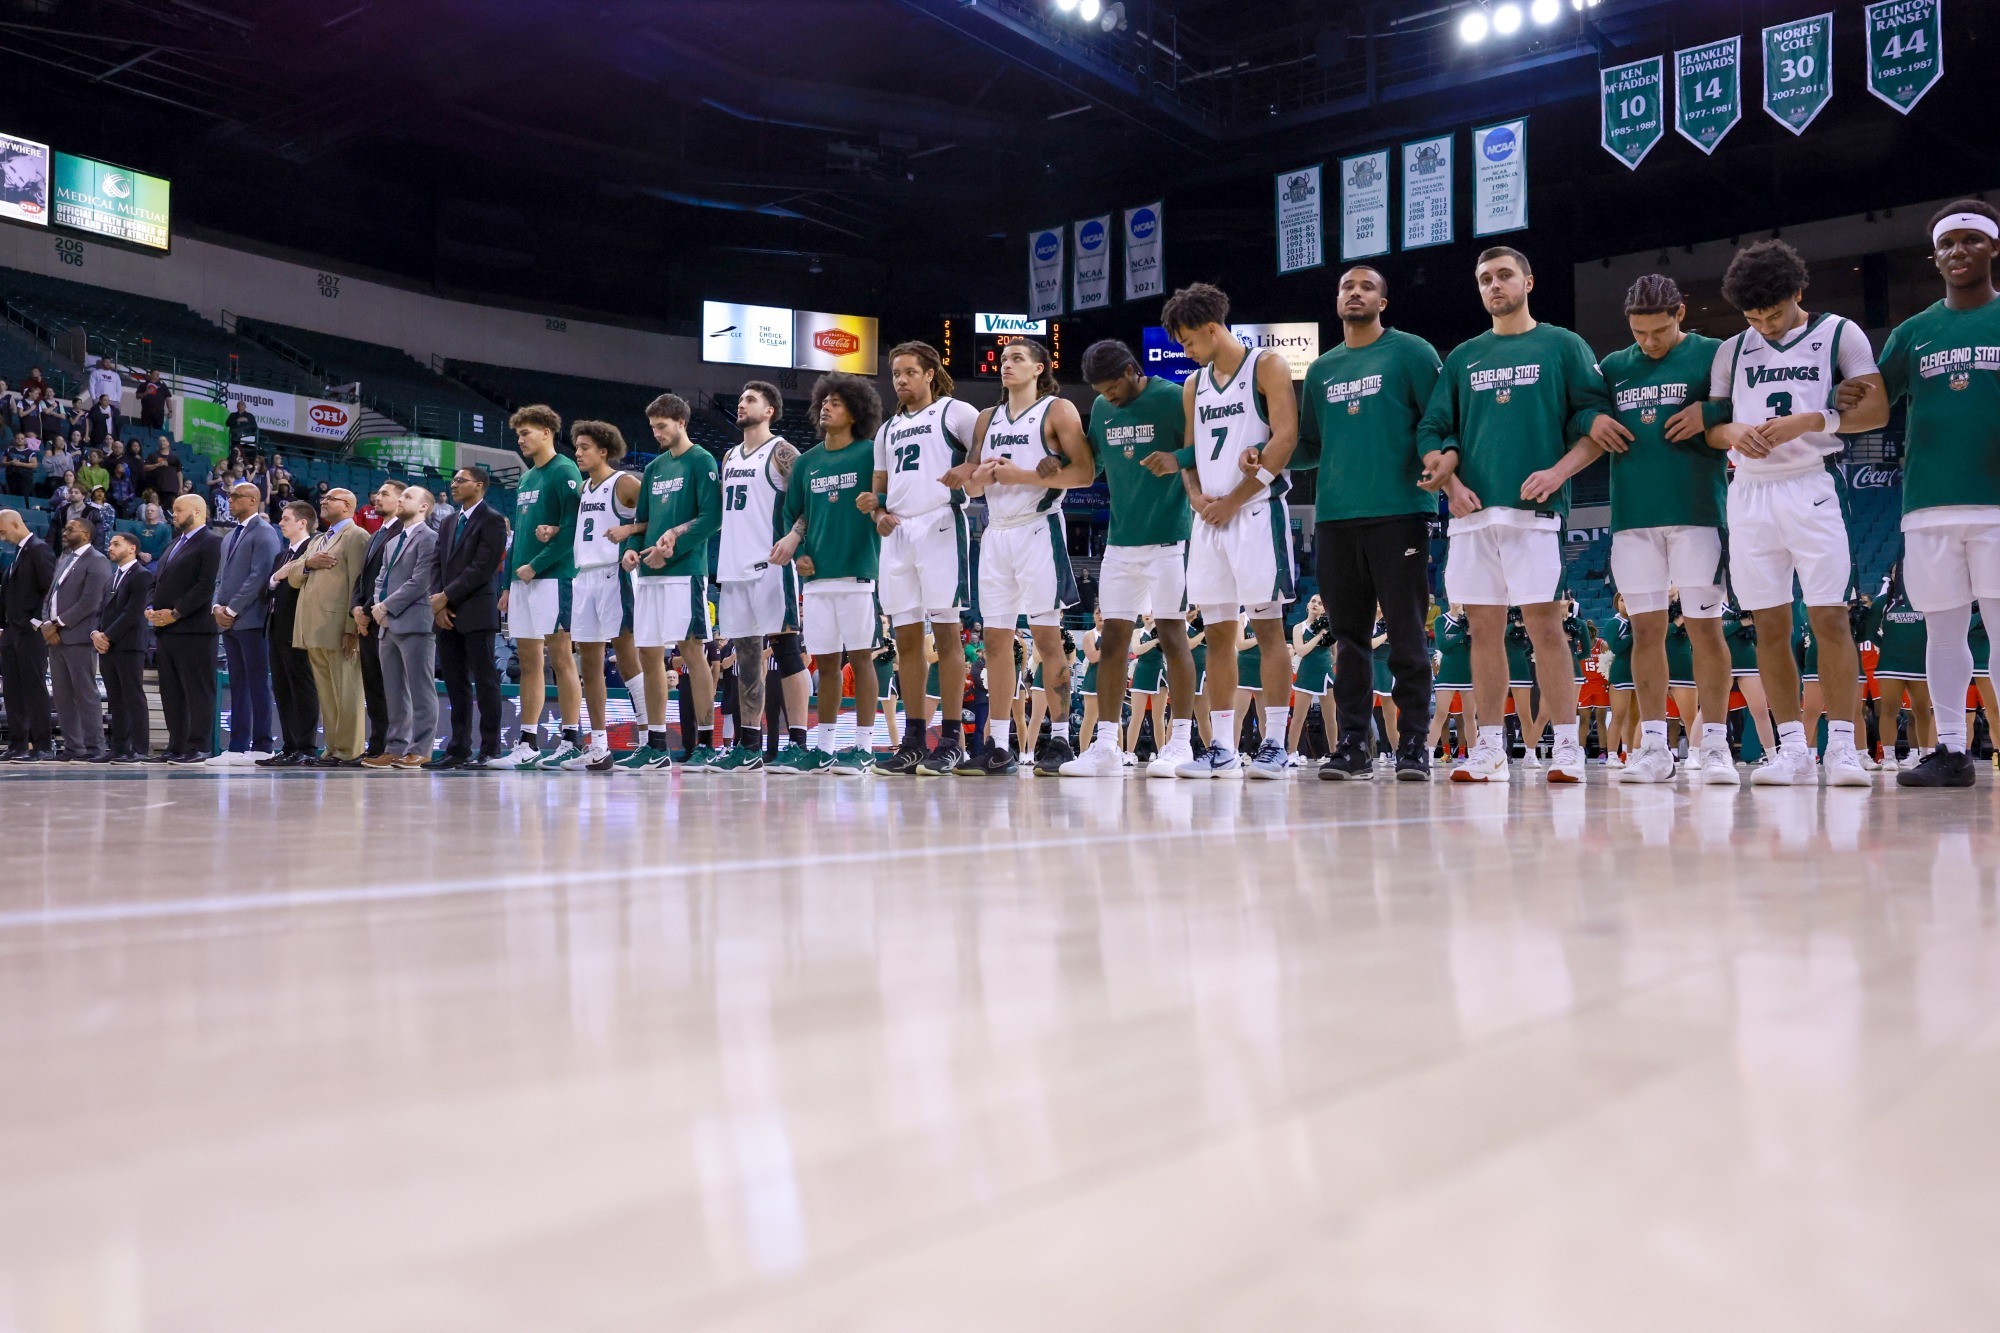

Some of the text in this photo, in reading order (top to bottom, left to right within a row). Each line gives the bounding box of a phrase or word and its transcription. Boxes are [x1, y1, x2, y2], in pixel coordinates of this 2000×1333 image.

[1872, 0, 1935, 21] CLINTON
[1876, 8, 1931, 31] RANSEY
[1773, 22, 1821, 43] NORRIS
[1780, 36, 1813, 52] COLE
[1881, 29, 1928, 60] 44
[1681, 44, 1735, 66] FRANKLIN
[1681, 55, 1735, 77] EDWARDS
[1780, 55, 1814, 82] 30
[1878, 59, 1933, 80] 1983-1987
[1620, 66, 1643, 81] KEN
[1694, 76, 1722, 103] 14
[1772, 83, 1823, 101] 2007-2011
[1620, 95, 1646, 119] 10
[1684, 103, 1732, 121] 1977-1981
[1611, 120, 1657, 138] 1985-1989
[1486, 141, 1516, 156] NCAA
[1482, 171, 1518, 182] APPEARANCES
[1411, 187, 1445, 197] APPEARANCES
[1412, 182, 1443, 192] POSTSEASON
[1492, 182, 1509, 190] 1986
[1431, 197, 1447, 205] 2011
[1491, 194, 1509, 202] 2009
[20, 203, 40, 213] OH!
[57, 187, 167, 223] MEDICAL MUTUAL
[1349, 200, 1380, 210] TOURNAMENT
[1409, 200, 1424, 209] 1987
[1431, 203, 1447, 211] 2012
[1408, 213, 1425, 221] 2008
[1409, 207, 1425, 215] 1988
[57, 204, 93, 218] OFFICIAL
[94, 211, 121, 226] HEALTH
[123, 220, 155, 235] INSURER
[158, 229, 167, 238] OF
[1356, 216, 1374, 225] 1986
[1431, 221, 1447, 229] 2023
[56, 213, 101, 229] CLEVELAND
[102, 223, 126, 237] STATE
[127, 230, 166, 246] ATHLETICS
[1133, 220, 1155, 234] NCAA
[1286, 224, 1315, 236] 1984-85
[1356, 223, 1375, 232] 2009
[1408, 225, 1425, 233] 2014
[1082, 233, 1104, 245] NCAA
[1286, 230, 1315, 242] 1985-86
[1356, 231, 1373, 239] 2021
[1408, 231, 1425, 239] 2015
[1431, 234, 1447, 242] 2025
[55, 237, 84, 253] 206
[1286, 237, 1315, 249] 1992-93
[1037, 244, 1058, 256] NCAA
[1286, 244, 1315, 256] 2010-11
[58, 250, 84, 267] 106
[1131, 256, 1156, 269] NCAA
[1286, 251, 1315, 262] 2020-21
[1286, 257, 1315, 268] 2021-22
[1079, 268, 1103, 280] NCAA
[318, 274, 340, 288] 207
[1035, 278, 1058, 290] NCAA
[320, 287, 339, 299] 107
[1134, 282, 1154, 293] 2021
[1081, 292, 1102, 304] 2009
[1037, 302, 1057, 314] 1986
[546, 319, 567, 330] 208
[944, 320, 950, 328] 2
[984, 315, 1039, 332] VIKINGS
[767, 338, 787, 346] CLEAR
[1257, 334, 1311, 352] Liberty
[942, 358, 950, 366] 12
[987, 351, 994, 361] 0
[1920, 346, 2000, 372] CLEVELAND STAT
[981, 364, 987, 372] 0
[1051, 361, 1059, 369] 15
[1944, 362, 1975, 373] VIKINGS
[1470, 364, 1540, 385] CLEVELAND STATE
[1745, 365, 1819, 388] VIKINGS
[1327, 374, 1382, 397] CLEVELAND STATE
[227, 391, 274, 407] untington
[1616, 383, 1688, 405] CLEVELAND STATE
[1636, 399, 1662, 407] VIKINGS
[1766, 391, 1793, 421] 3
[311, 408, 344, 423] OH!
[1199, 402, 1245, 424] VIKINGS
[311, 426, 345, 436] LOTTERY
[890, 424, 932, 446] VIKINGS
[1106, 424, 1155, 440] CLEVELAND STATE
[990, 433, 1030, 450] VIKINGS
[1210, 427, 1228, 461] 7
[895, 443, 920, 474] 12
[724, 467, 756, 481] VIKINGS
[811, 472, 858, 489] CLEVELAND STATE
[725, 484, 748, 511] 15
[580, 502, 605, 514] VIKINGS
[583, 518, 594, 542] 2
[1585, 661, 1596, 671] 15
